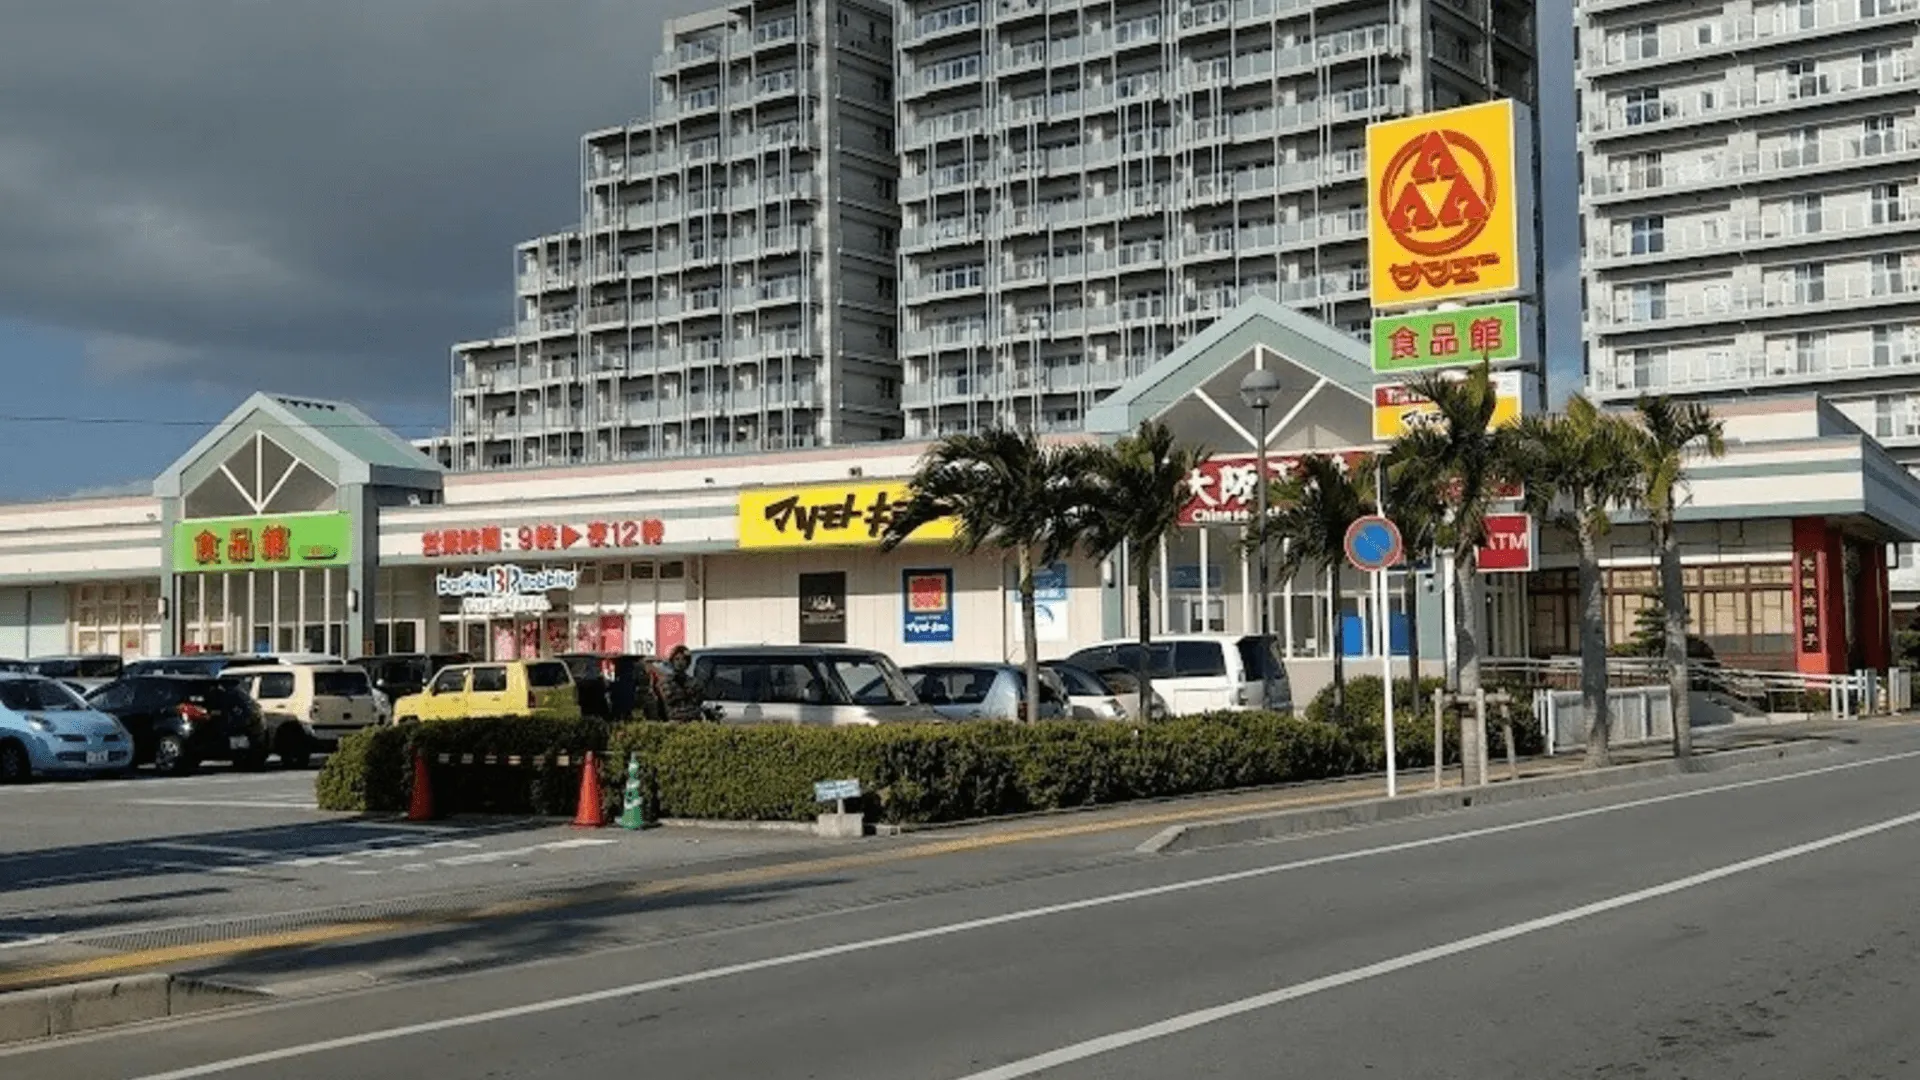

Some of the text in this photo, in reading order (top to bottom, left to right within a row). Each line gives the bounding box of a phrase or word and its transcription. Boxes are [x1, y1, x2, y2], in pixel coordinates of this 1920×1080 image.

[1389, 253, 1500, 292] サンエー
[1388, 316, 1503, 360] 食品館
[194, 524, 292, 566] 食品館
